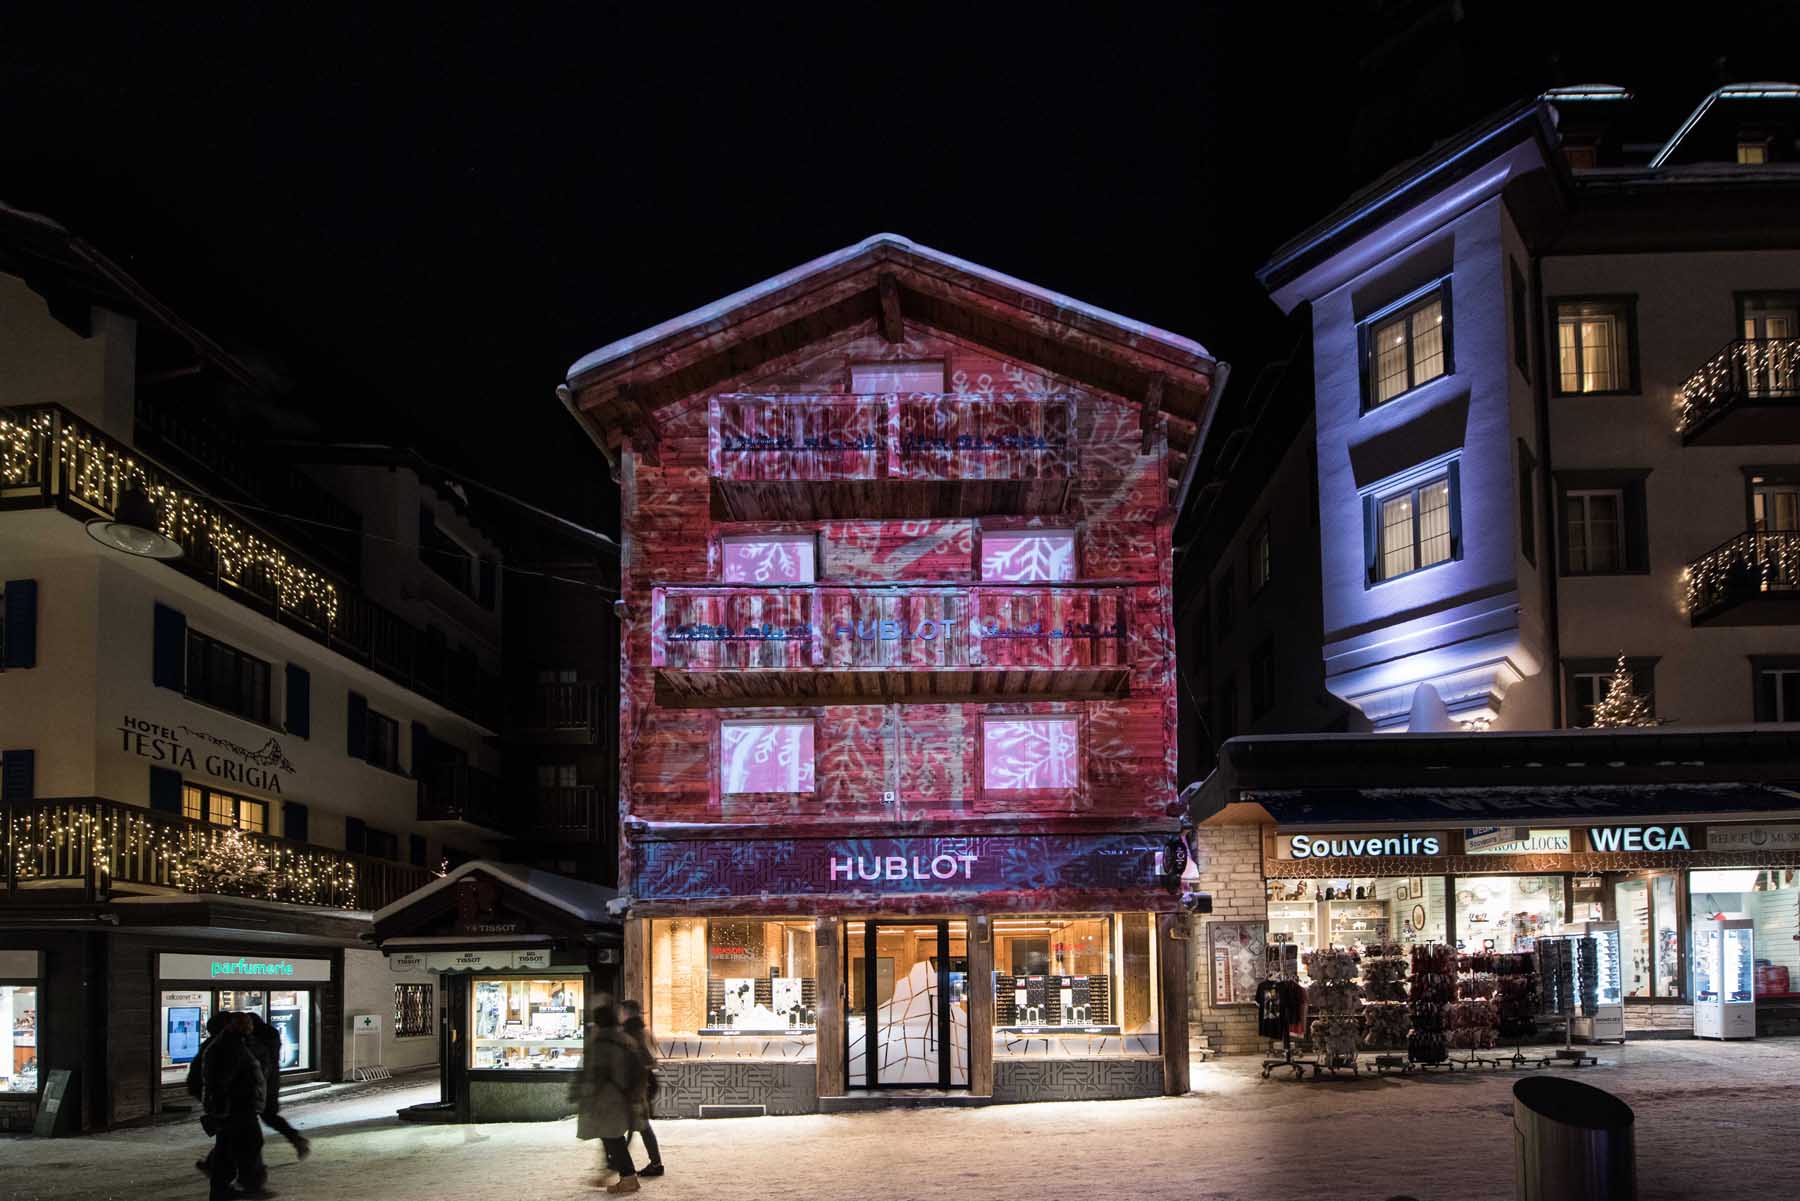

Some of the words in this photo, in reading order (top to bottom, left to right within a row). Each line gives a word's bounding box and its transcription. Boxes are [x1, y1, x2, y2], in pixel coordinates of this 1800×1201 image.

[835, 619, 955, 641] HUBLOT
[124, 715, 179, 741] HOTEL
[117, 727, 197, 770] TESTA
[205, 755, 282, 793] GRIGIA
[1291, 833, 1440, 858] Souvenirs
[1521, 836, 1568, 851] CLOCKS
[1591, 826, 1691, 851] WEGA
[830, 854, 978, 881] HUBLOT
[480, 924, 517, 932] TISSOT
[211, 958, 293, 977] parfumerie
